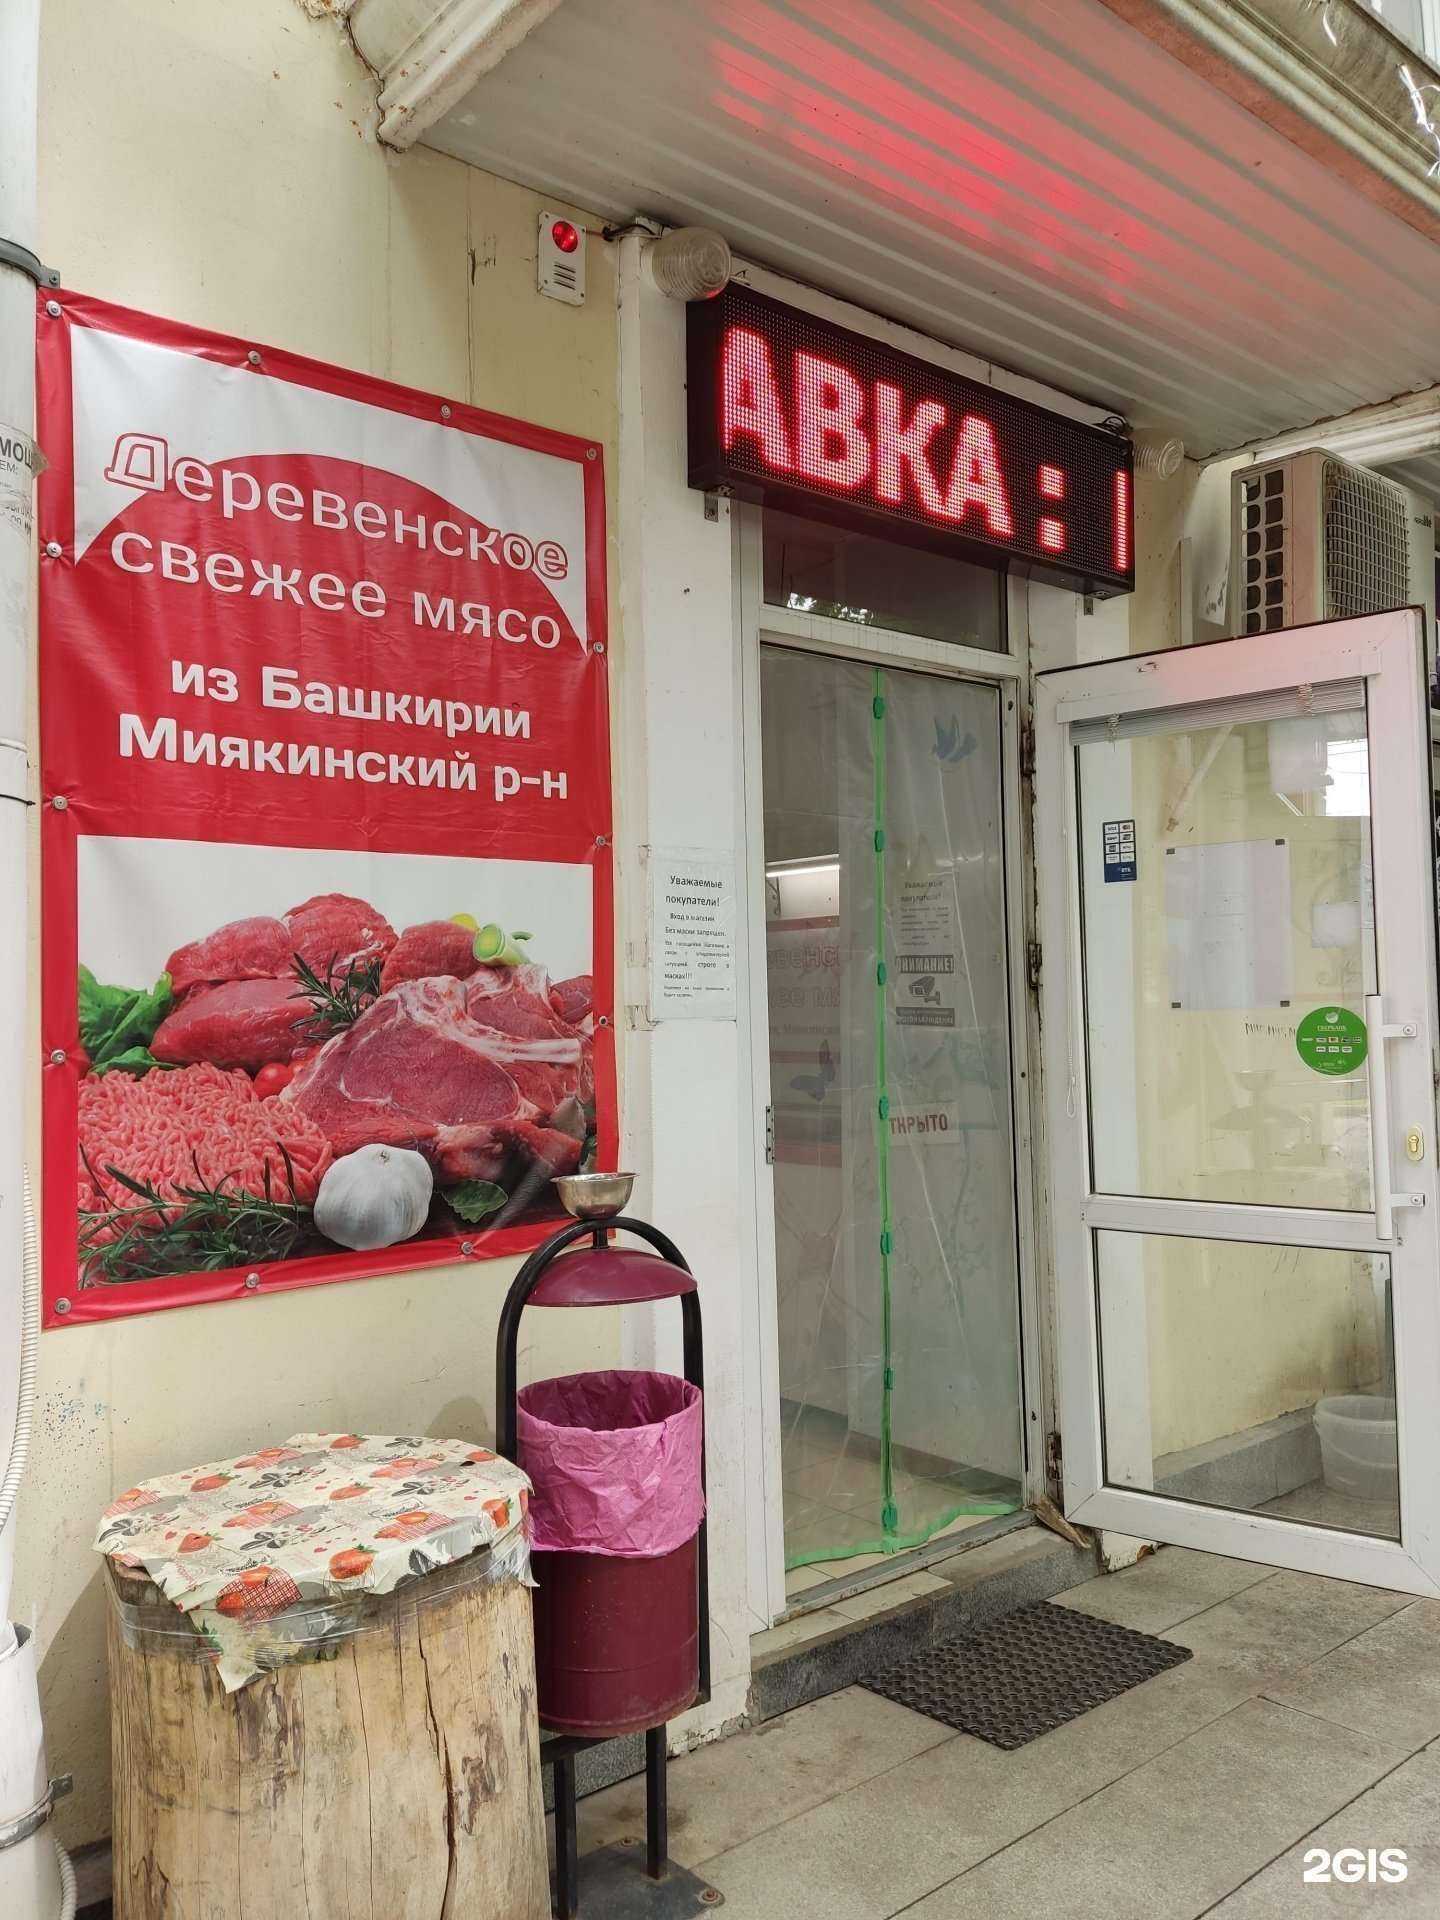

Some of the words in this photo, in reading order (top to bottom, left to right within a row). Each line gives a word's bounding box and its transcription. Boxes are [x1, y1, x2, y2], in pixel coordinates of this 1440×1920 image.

[723, 327, 1014, 538] АВКА
[104, 432, 569, 581] Деревенское
[111, 531, 387, 618] свежее
[414, 591, 561, 650] мясо
[171, 660, 238, 702] из
[262, 667, 531, 739] Башкирии
[119, 713, 477, 792] Миякинский
[494, 764, 568, 802] р-н
[665, 895, 720, 907] покупатели!
[670, 875, 723, 889] Уважаемые
[888, 1113, 948, 1134] ТКРЫТО
